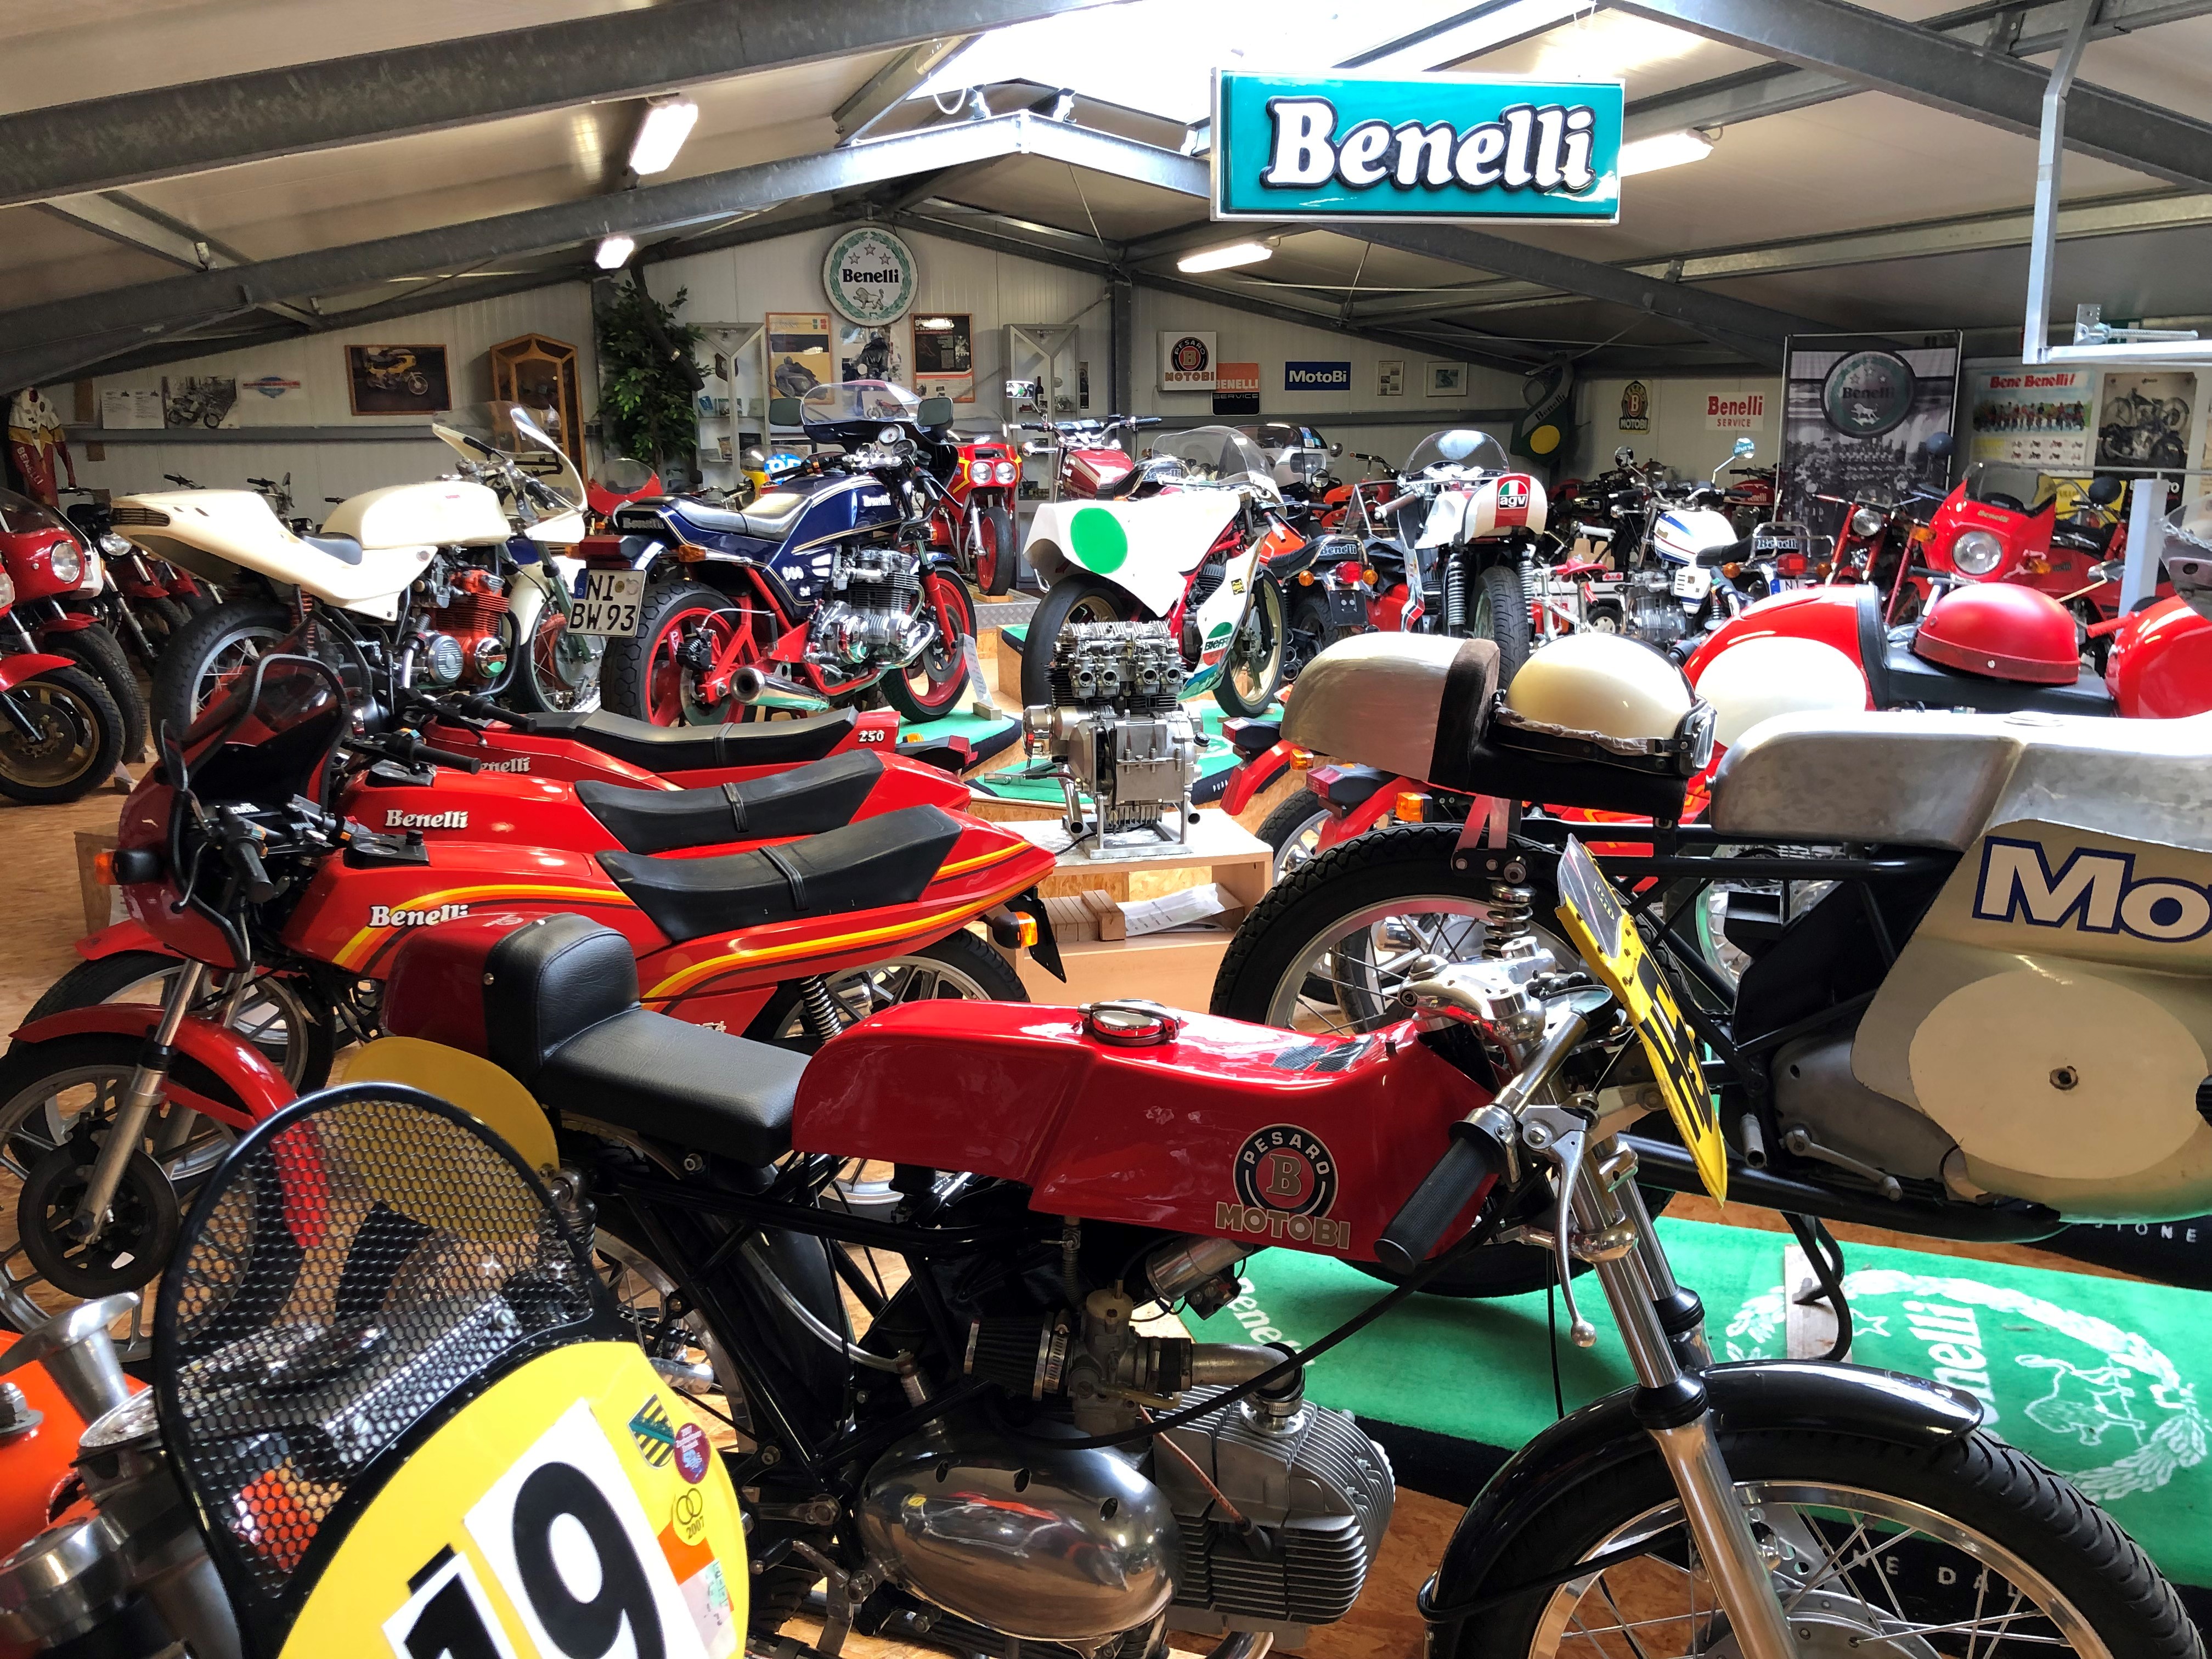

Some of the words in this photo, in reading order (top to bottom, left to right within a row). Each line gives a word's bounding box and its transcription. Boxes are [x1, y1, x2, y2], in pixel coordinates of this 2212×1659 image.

[1260, 95, 1596, 194] Benelli
[842, 268, 899, 283] Benelli
[1174, 340, 1205, 355] PESARO
[1183, 350, 1197, 366] B
[1165, 371, 1215, 382] MOTOBI
[1289, 370, 1347, 383] MotoBi
[1990, 376, 2021, 388] Bene
[2024, 374, 2076, 388] Benelli!
[1535, 394, 1566, 421] Benelli
[1631, 394, 1639, 412] B
[1707, 396, 1763, 416] Benelli
[1717, 419, 1751, 427] SERVICE
[17, 447, 44, 485] BENELLI
[1143, 468, 1182, 482] Beelli
[1499, 495, 1527, 508] agv
[1319, 544, 1357, 556] Benelli
[585, 575, 616, 601] NI
[569, 603, 602, 630] BW
[607, 605, 637, 631] 93
[858, 729, 885, 742] 250
[479, 757, 531, 772] enelli
[230, 803, 260, 814] enelli
[385, 809, 469, 830] Benelli
[1972, 834, 2212, 943] Mo
[368, 904, 469, 929] Benelli
[1243, 1131, 1330, 1175] PESARO
[1266, 1153, 1302, 1197] B
[1215, 1201, 1351, 1250] MOTOBI
[686, 1515, 705, 1539] 2007
